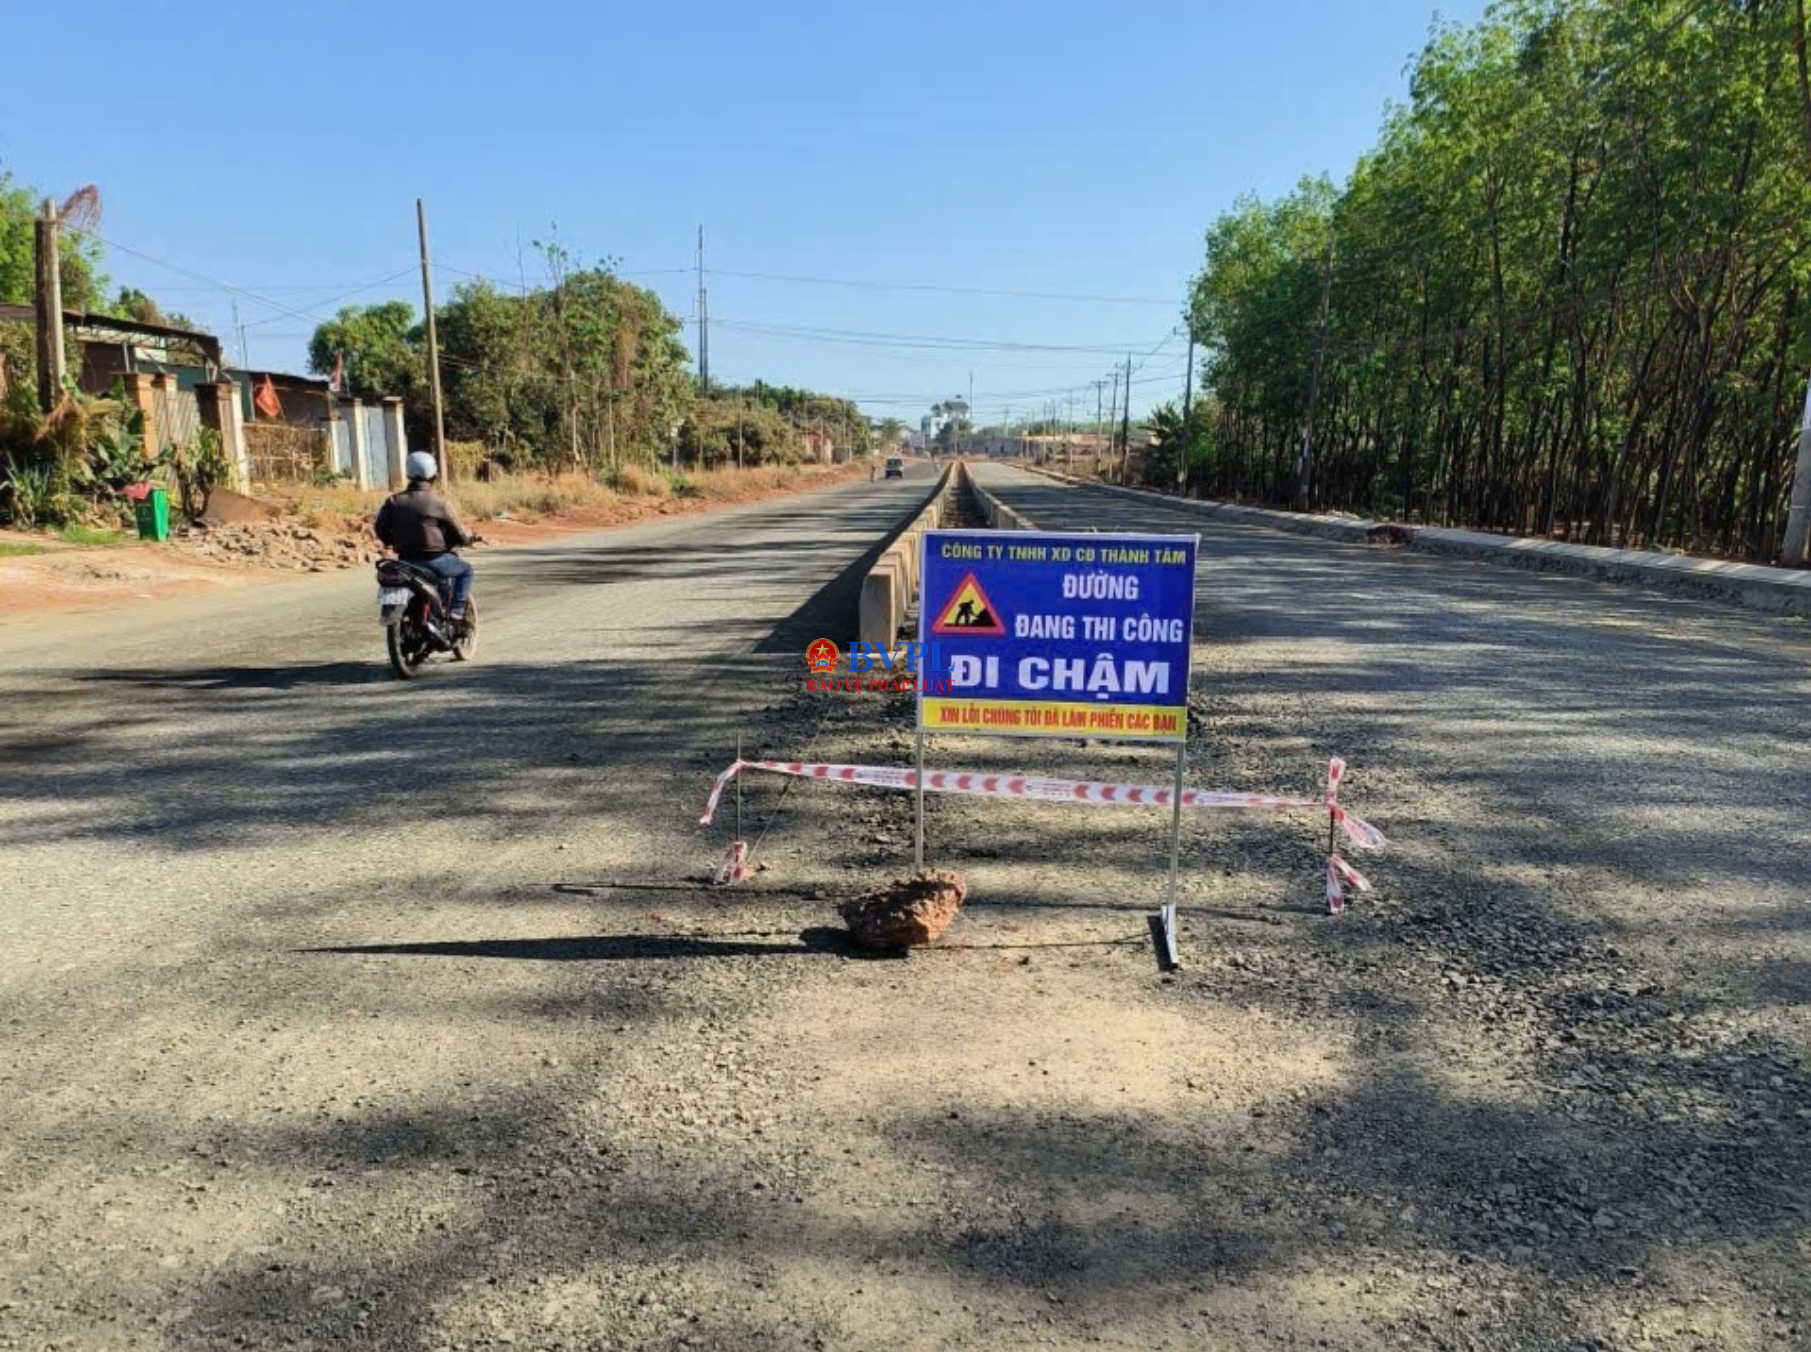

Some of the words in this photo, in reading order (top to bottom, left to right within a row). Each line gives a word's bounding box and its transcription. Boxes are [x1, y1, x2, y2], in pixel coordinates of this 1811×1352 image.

[942, 541, 982, 559] CÔNG
[987, 545, 1004, 560] TY
[1008, 545, 1047, 561] TNHH
[1100, 546, 1150, 563] THÀNH
[1154, 547, 1186, 564] TÂM
[1062, 569, 1139, 600] ĐƯỜNG
[1015, 614, 1075, 640] ĐANG
[1084, 616, 1116, 641] THI
[1123, 613, 1183, 643] CÔNG
[950, 655, 998, 688] ĐI
[1018, 653, 1171, 699] CHẬM
[939, 706, 959, 724] XIN
[983, 705, 1021, 726] CHÚNG
[1024, 706, 1041, 726] TÔI
[1127, 711, 1150, 730] CÁC
[1153, 714, 1177, 734] BẠN
